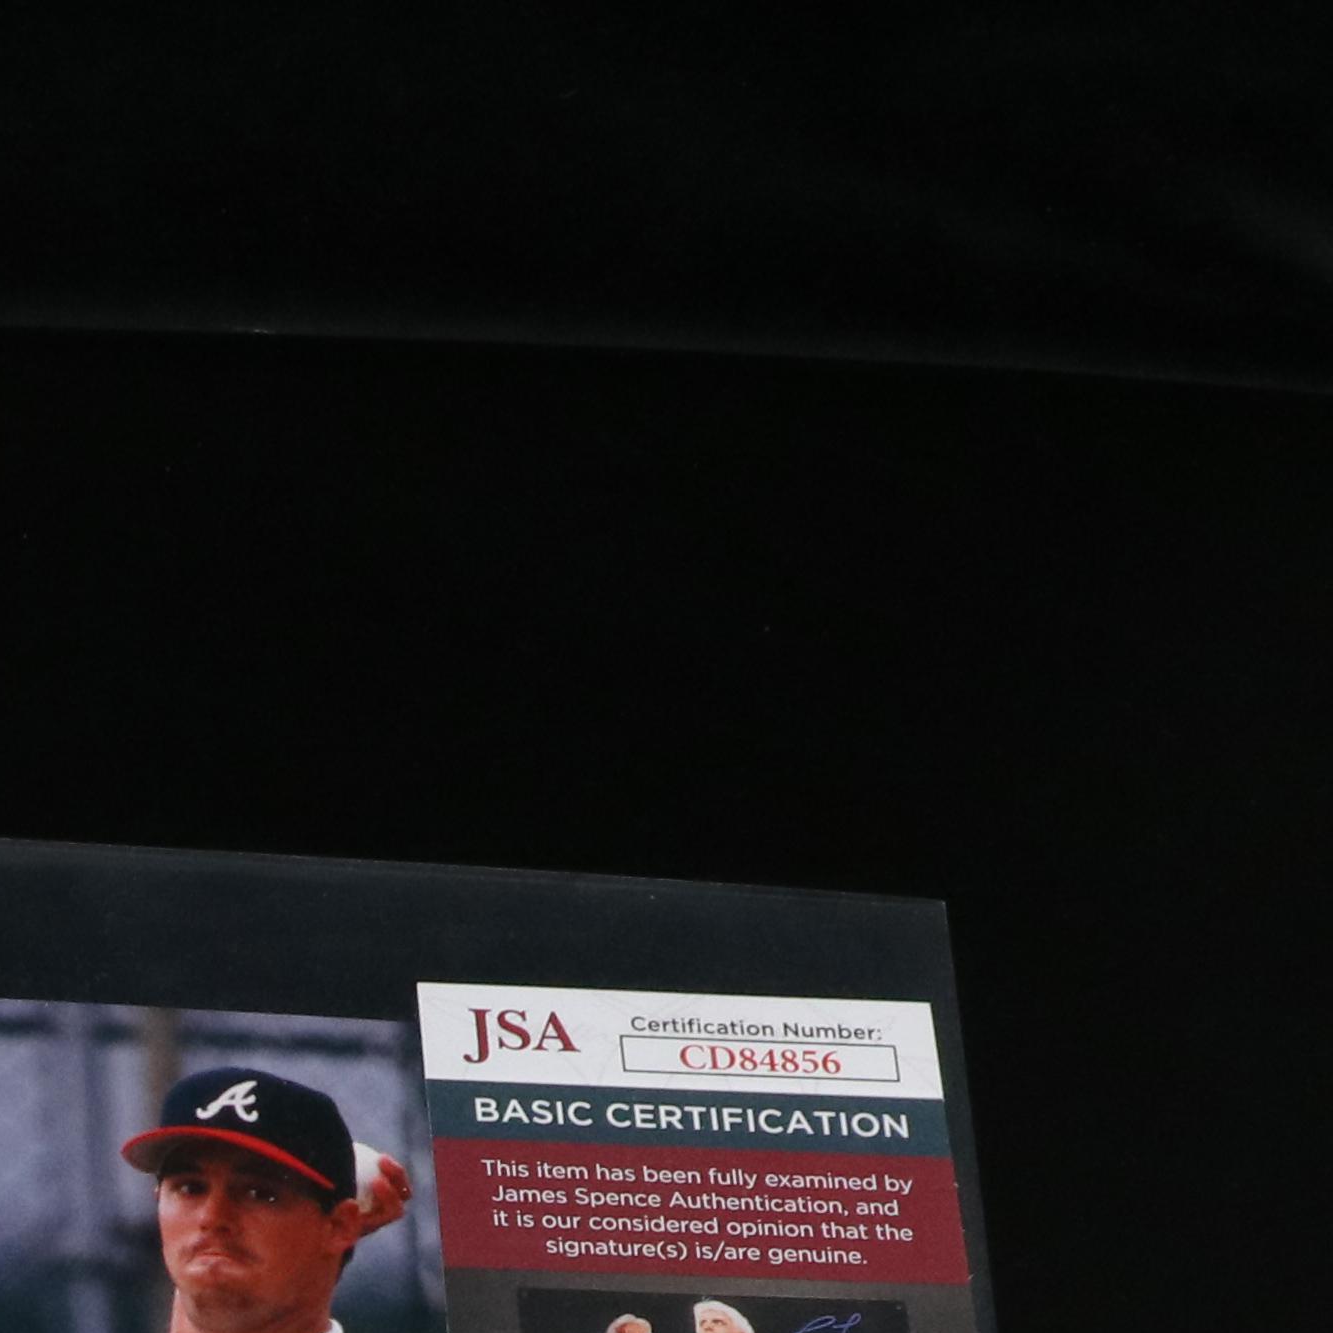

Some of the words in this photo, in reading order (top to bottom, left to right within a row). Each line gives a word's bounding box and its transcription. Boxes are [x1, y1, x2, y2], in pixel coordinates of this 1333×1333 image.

[463, 1008, 581, 1064] JSA
[630, 1016, 775, 1037] Certification
[782, 1022, 882, 1041] Number:
[679, 1044, 841, 1075] CD84856
[474, 1097, 593, 1126] BASIC
[605, 1102, 909, 1139] CERTIFICATION
[480, 1159, 530, 1178] This
[536, 1160, 589, 1180] item
[595, 1162, 636, 1182] has
[642, 1165, 701, 1184] been
[707, 1167, 758, 1190] fully
[764, 1172, 878, 1191] examined
[883, 1174, 913, 1196] by
[491, 1184, 568, 1204] James
[574, 1187, 662, 1208] Spence
[669, 1191, 849, 1217] Authentication,
[855, 1199, 899, 1217] and
[493, 1208, 509, 1227] it
[516, 1209, 535, 1228] is
[541, 1214, 581, 1229] our
[588, 1214, 719, 1235] considered
[726, 1218, 814, 1239] opinion
[820, 1221, 869, 1240] that
[875, 1223, 913, 1242] the
[545, 1236, 688, 1261] signature(s)
[695, 1240, 761, 1262] is/are
[767, 1246, 868, 1265] genuine.
